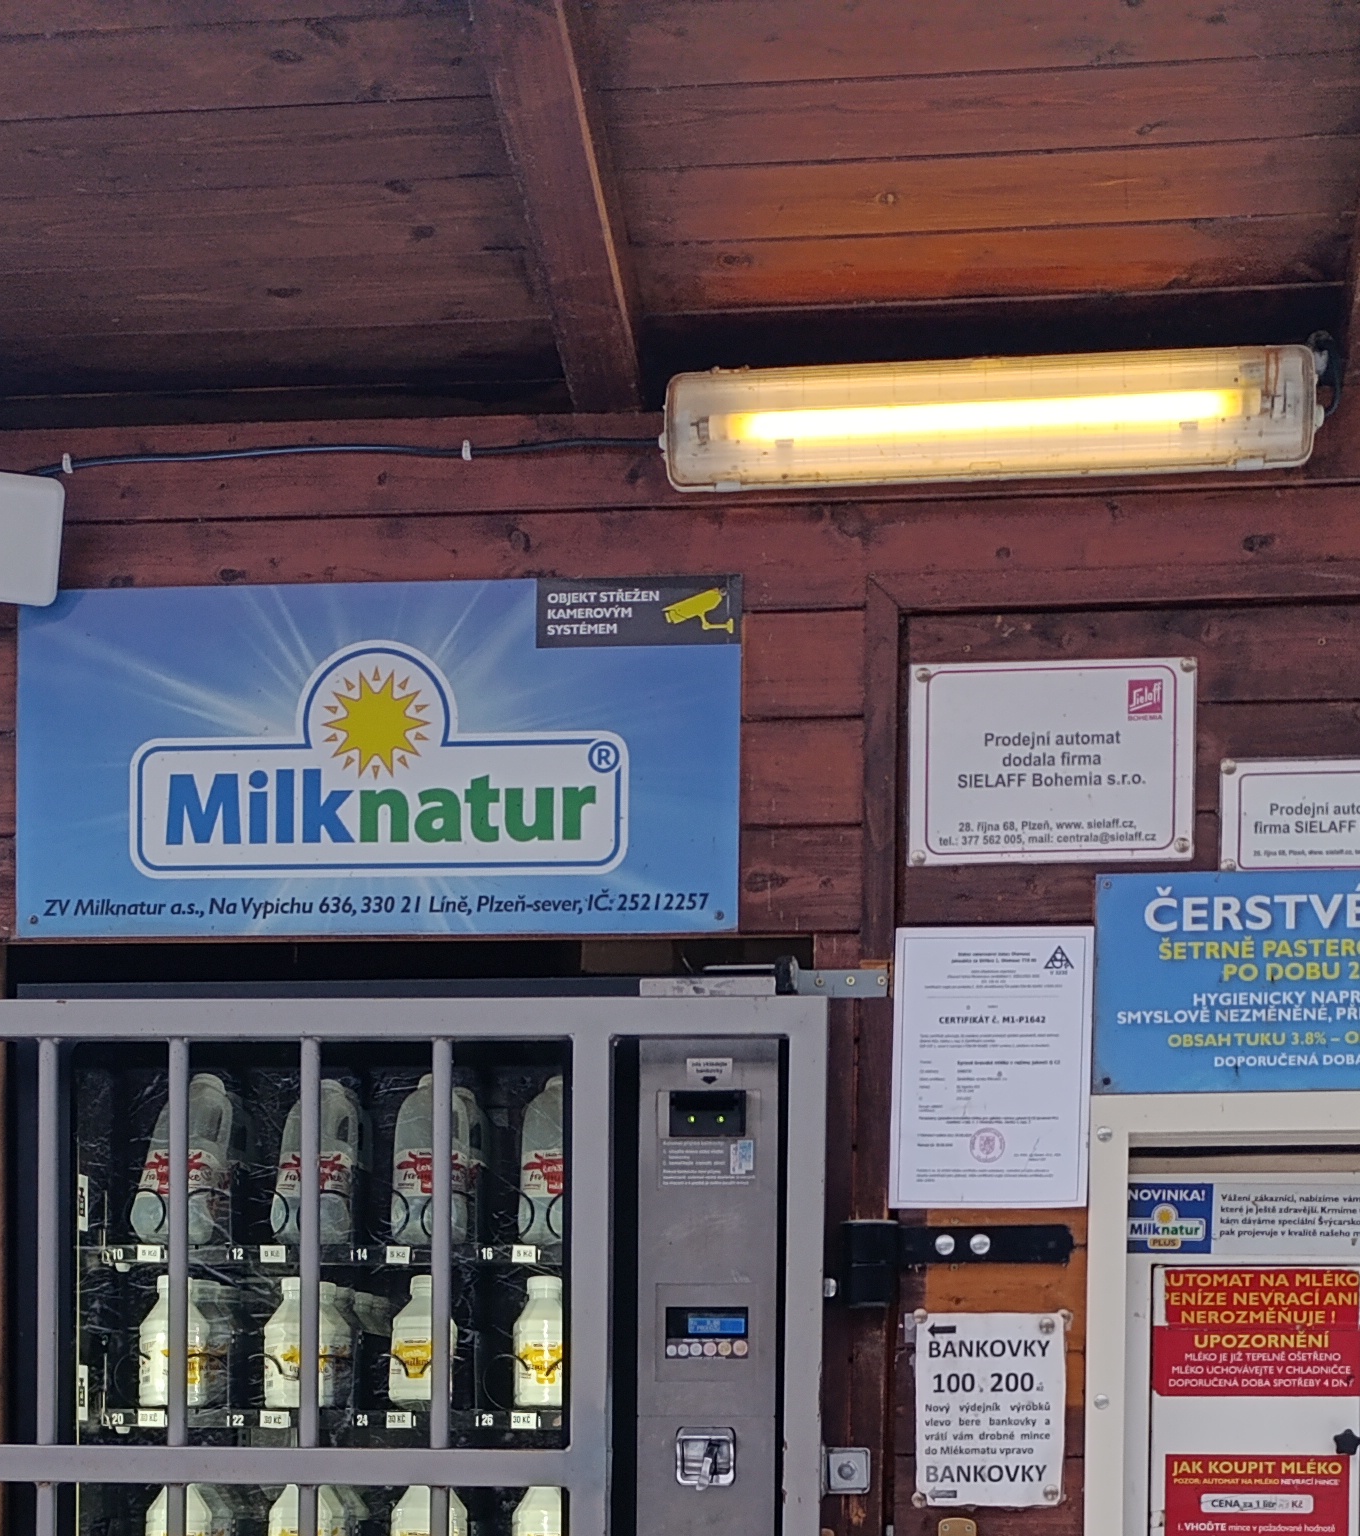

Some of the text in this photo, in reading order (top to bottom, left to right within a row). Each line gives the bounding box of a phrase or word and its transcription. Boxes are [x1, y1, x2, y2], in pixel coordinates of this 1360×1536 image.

[548, 589, 659, 605] OBJEKT STŘEŽEN
[548, 603, 632, 619] KAMEROVÝM
[547, 621, 617, 635] SYSTÉMEM
[985, 731, 1120, 749] Prodejní automat
[1003, 751, 1101, 767] dodala firma
[958, 772, 1146, 788] SIELAFF Bohemia s.r.o.
[165, 768, 597, 846] Milknatur
[1270, 803, 1328, 817] Prodejní
[1254, 821, 1290, 834] firma
[1295, 821, 1356, 833] SIELAFF
[44, 899, 70, 916] ZV
[74, 898, 166, 916] Milknatur
[170, 902, 204, 918] a.s.,
[209, 898, 237, 914] Na
[241, 897, 313, 919] Vypichu
[319, 896, 357, 917] 636,
[361, 896, 395, 913] 330
[401, 896, 421, 913] 21
[477, 894, 583, 914] Plzeň-sever,
[1160, 937, 1254, 960] ŠETRNĚ
[1224, 964, 1258, 981] PO
[1267, 963, 1341, 980] DOBU
[1194, 991, 1306, 1008] HYGIENICKY
[938, 1015, 990, 1025] CERTIFIKÁT
[1117, 1006, 1209, 1024] SMYSLOVĚ
[1216, 1004, 1332, 1022] NEZMĚNĚNÉ,
[1167, 1034, 1231, 1048] OBSAH
[1234, 1033, 1286, 1047] TUKU
[1291, 1031, 1327, 1046] 3.8%
[1214, 1053, 1318, 1067] DOPORUČENÁ
[1128, 1189, 1205, 1201] NOVINKA!
[1130, 1223, 1200, 1236] Milknatur
[1152, 1239, 1177, 1247] PLUS
[1260, 1274, 1289, 1287] NA
[1296, 1270, 1360, 1287] MLÉKO
[1233, 1289, 1319, 1305] NEVRACÍ
[1323, 1292, 1358, 1306] ANI
[1182, 1307, 1325, 1327] NEROZMĚŇUJE
[1195, 1331, 1329, 1348] UPOZORNĚNÍ
[929, 1339, 1050, 1358] BANKOVKY
[991, 1373, 1035, 1392] 200
[924, 1401, 1051, 1415] Nový výdejník výrobků
[924, 1416, 1051, 1428] vlevo bere bankovky a
[924, 1430, 1051, 1441] vrátí vám drobné mince
[924, 1445, 1034, 1457] do Mlékomatu vpravo
[927, 1465, 1046, 1483] BANKOVKY
[1172, 1459, 1342, 1476] JAK KOUPIT MLÉKO
